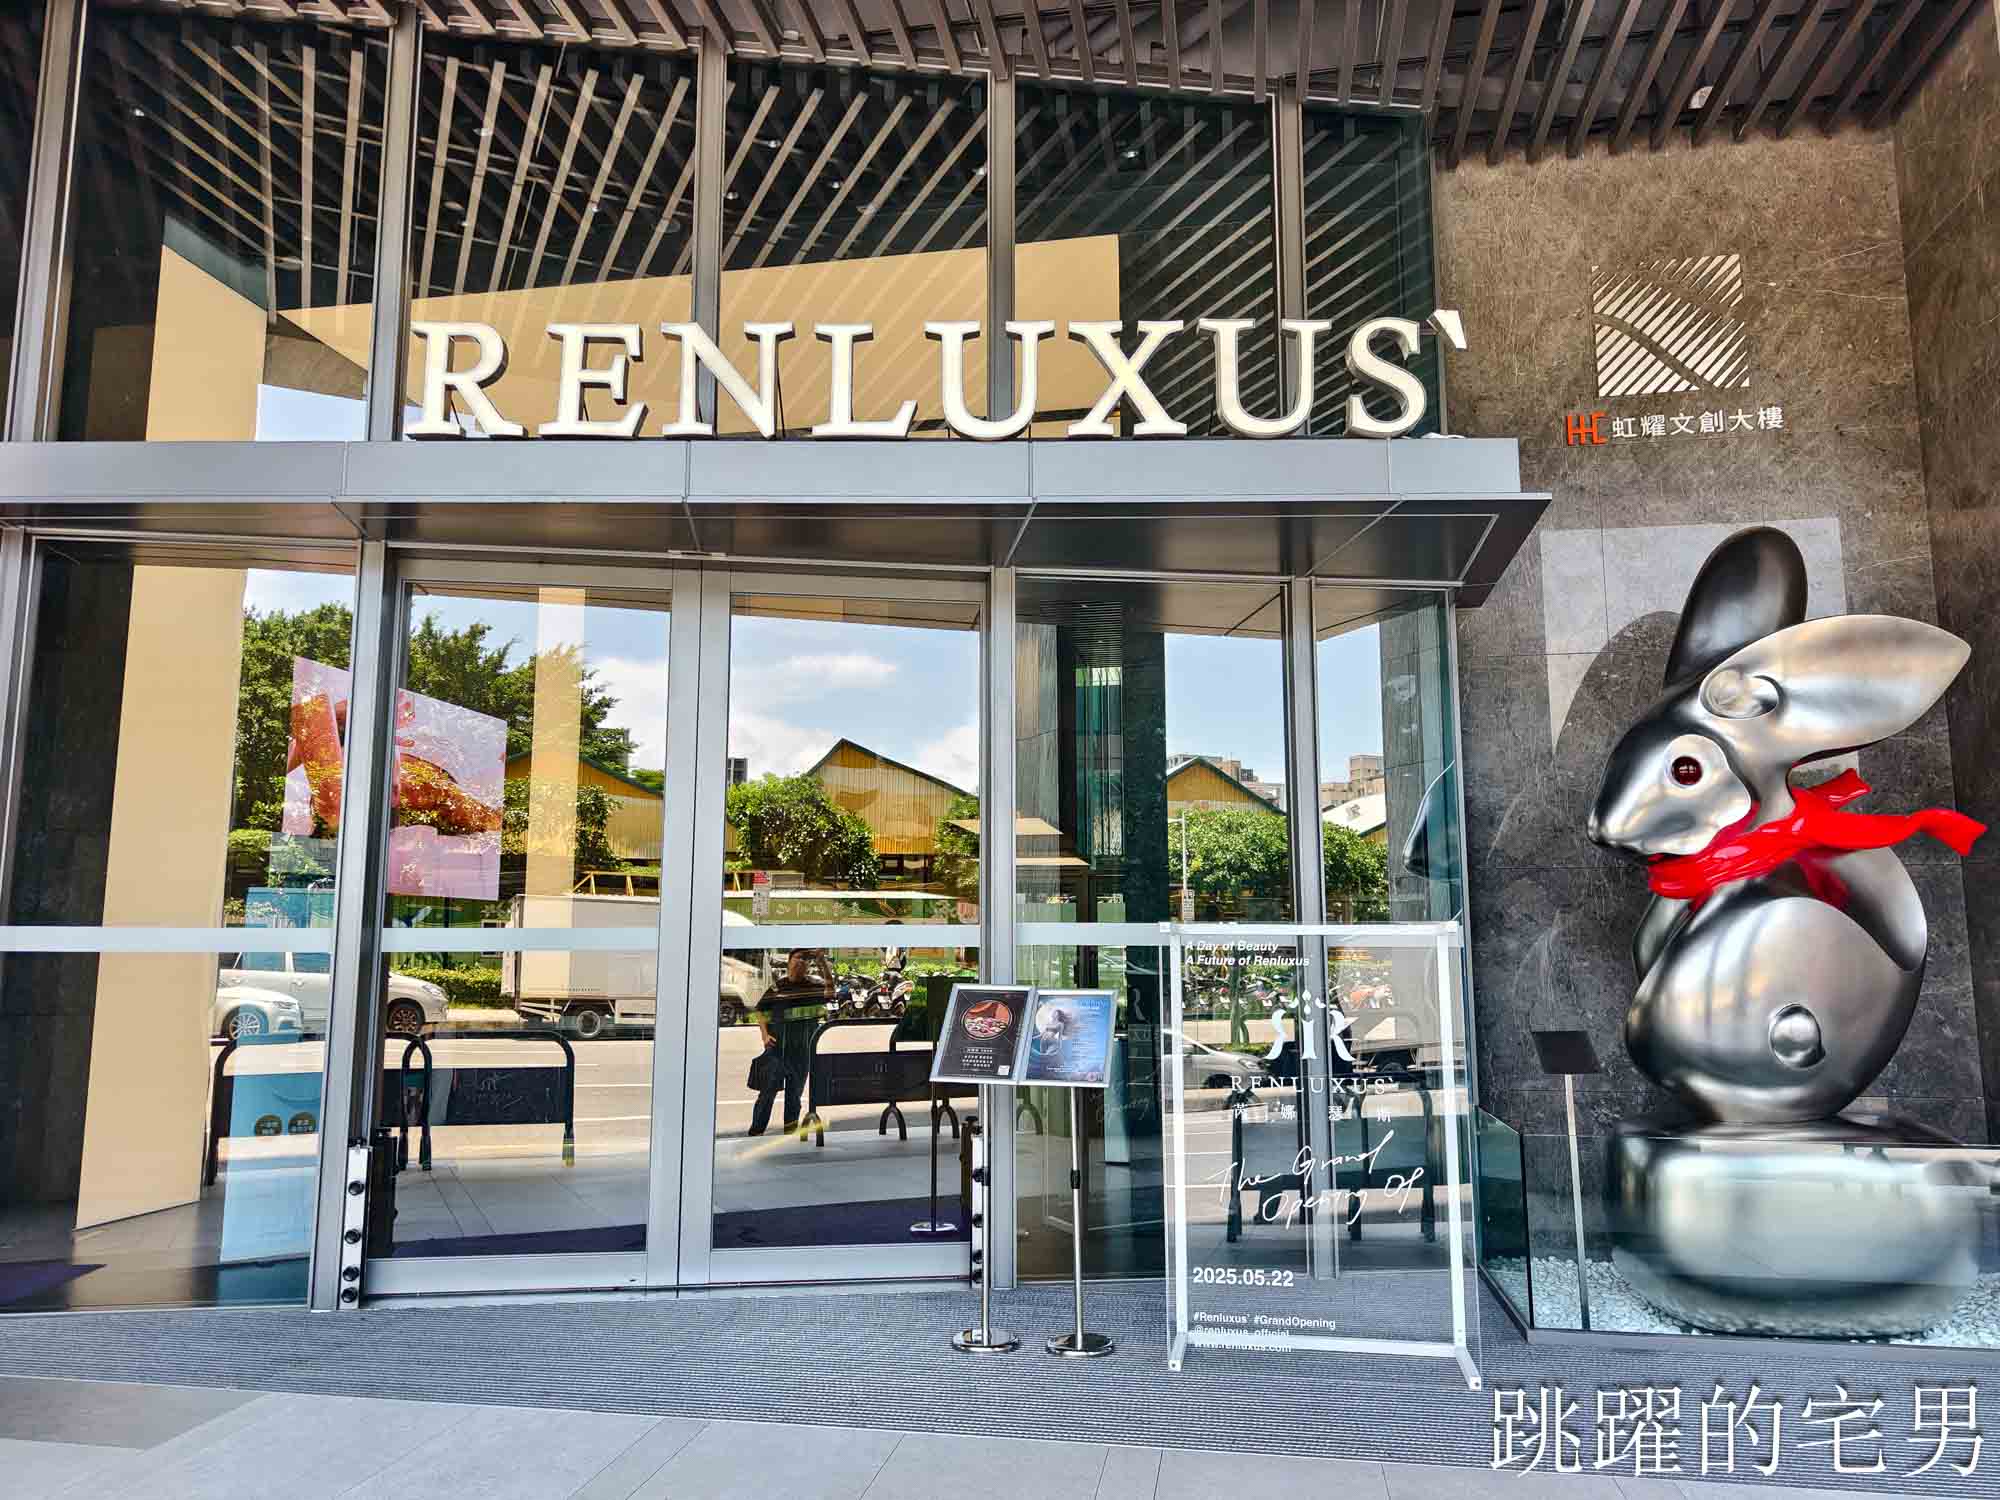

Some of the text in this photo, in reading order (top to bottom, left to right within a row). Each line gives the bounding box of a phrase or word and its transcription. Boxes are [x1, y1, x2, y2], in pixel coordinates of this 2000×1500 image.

[1611, 405, 1785, 439] 虹耀文創大樓
[1184, 940, 1279, 954] A Day of Beauty
[1184, 955, 1194, 966] A
[1197, 955, 1236, 967] Future
[1238, 955, 1251, 967] of
[1207, 1129, 1395, 1202] The Grand
[1262, 1189, 1368, 1230] Opening
[1192, 1266, 1294, 1288] 2025.05.22
[1253, 1314, 1336, 1330] #GrandOpening
